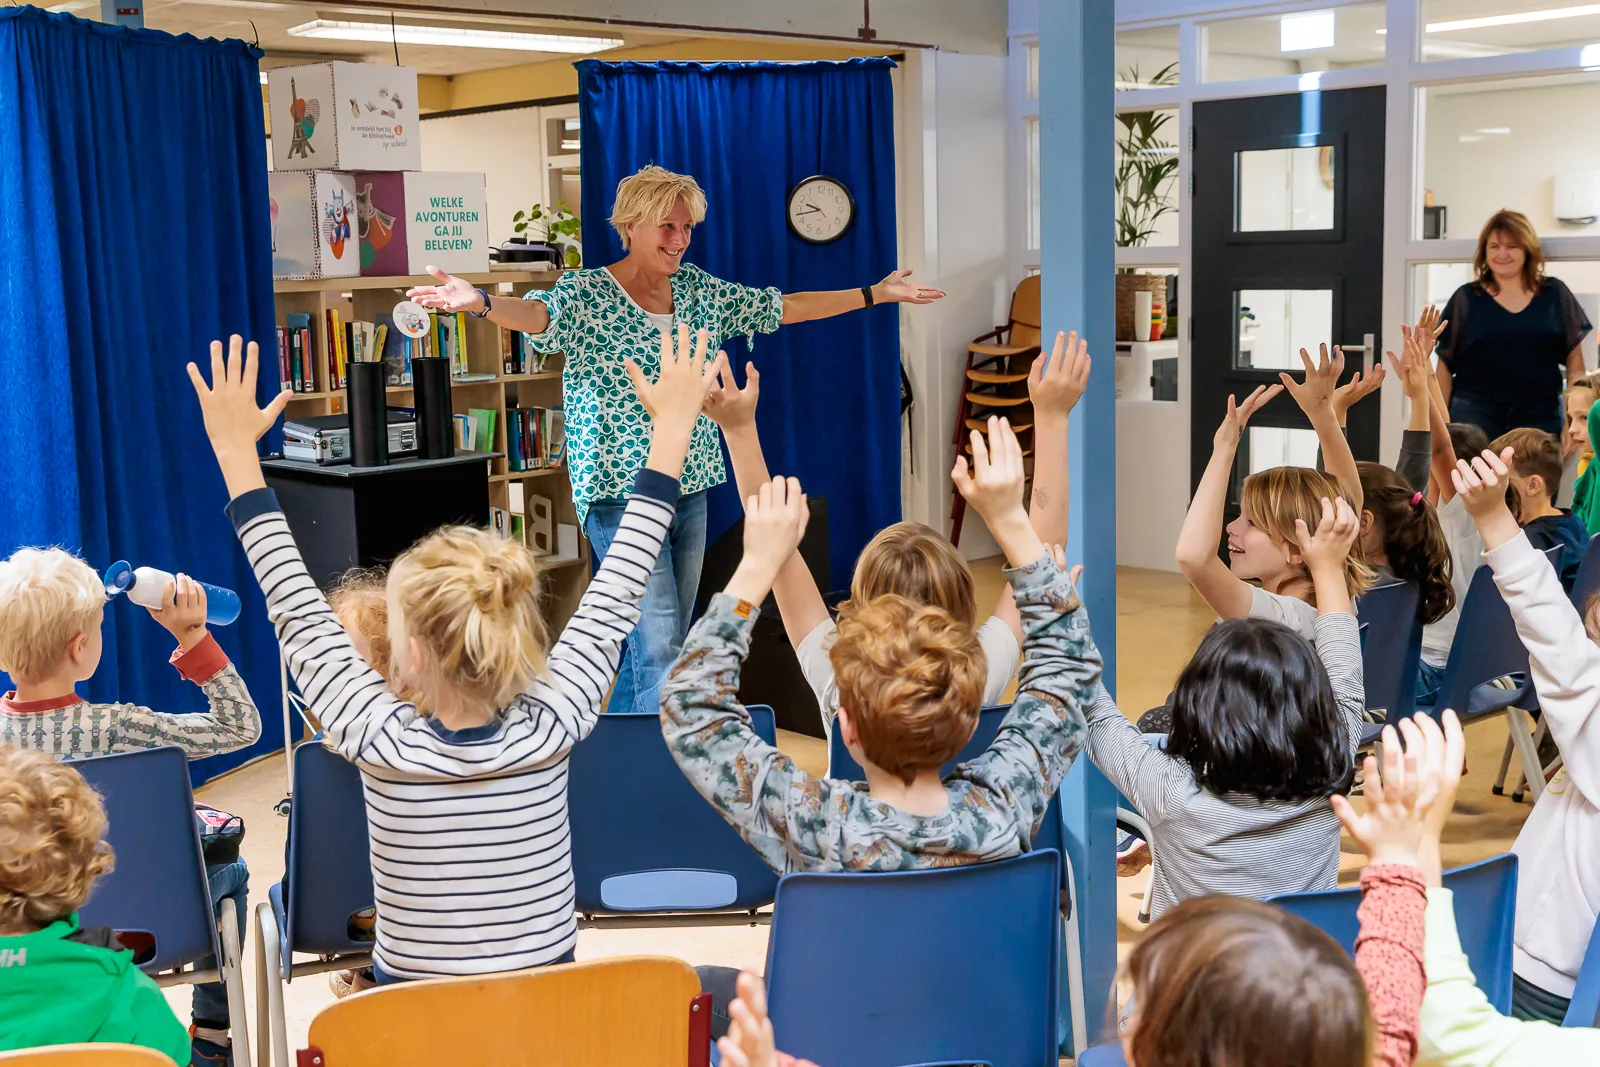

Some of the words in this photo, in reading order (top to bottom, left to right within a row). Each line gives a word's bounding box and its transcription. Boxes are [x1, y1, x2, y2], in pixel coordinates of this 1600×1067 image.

[382, 142, 390, 151] op
[390, 137, 407, 147] school
[817, 185, 826, 194] 12
[828, 188, 834, 197] 11
[429, 197, 464, 208] WELKE
[799, 195, 806, 204] 2
[835, 196, 844, 205] 10
[838, 206, 844, 215] 9
[415, 211, 479, 222] AVONTUREN
[799, 216, 805, 224] 4
[834, 216, 841, 225] 8
[434, 226, 450, 237] GA
[451, 226, 463, 237] JIJ
[806, 224, 813, 233] 5
[815, 227, 823, 236] 6
[424, 239, 473, 251] BELEVEN?
